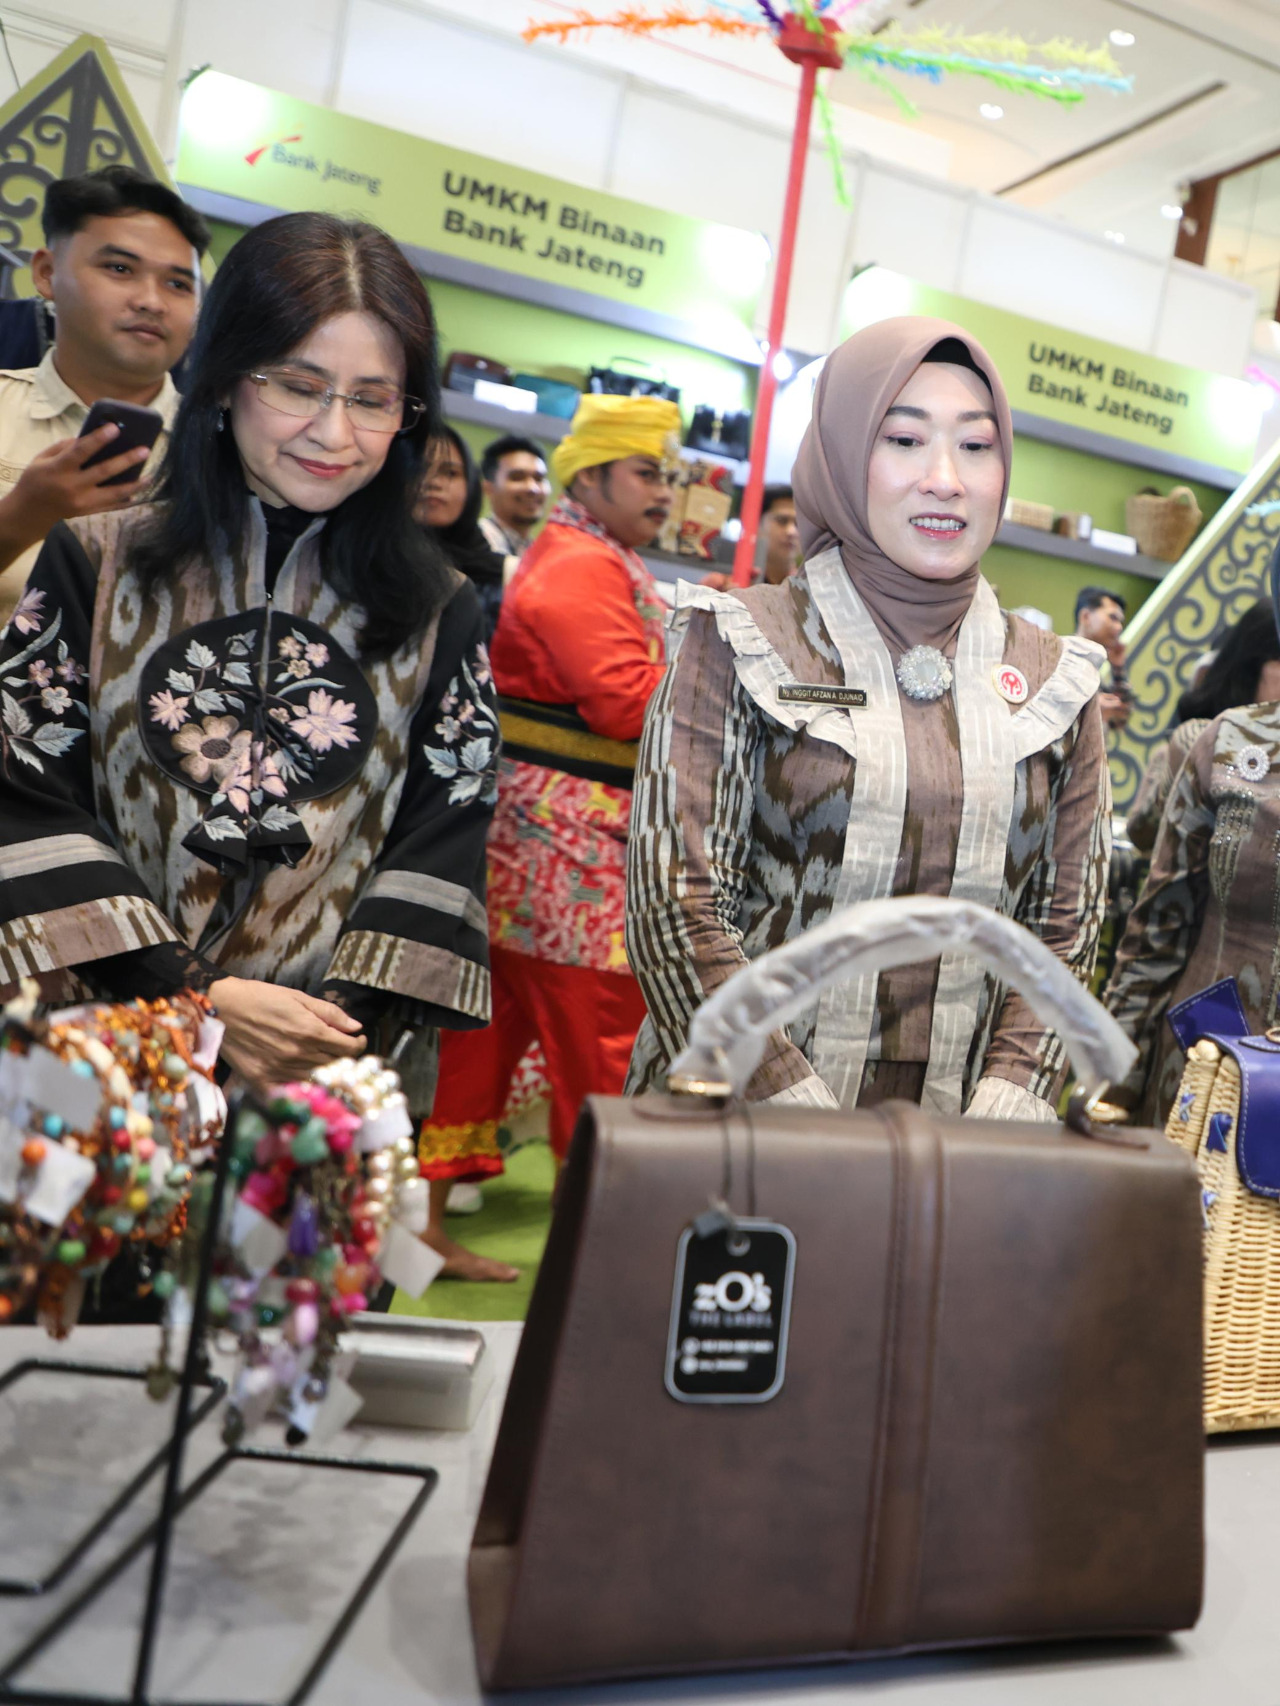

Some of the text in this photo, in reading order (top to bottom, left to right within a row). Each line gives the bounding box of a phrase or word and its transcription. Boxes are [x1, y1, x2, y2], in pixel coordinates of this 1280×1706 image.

[271, 142, 382, 196] Bank Jateng
[443, 170, 667, 256] UMKM Binaan
[443, 209, 646, 288] Bank Jateng
[1028, 342, 1189, 407] UMKM Binaan
[1028, 373, 1174, 435] Bank Jateng
[792, 688, 812, 698] INGGIT
[838, 692, 864, 702] DJUNAID
